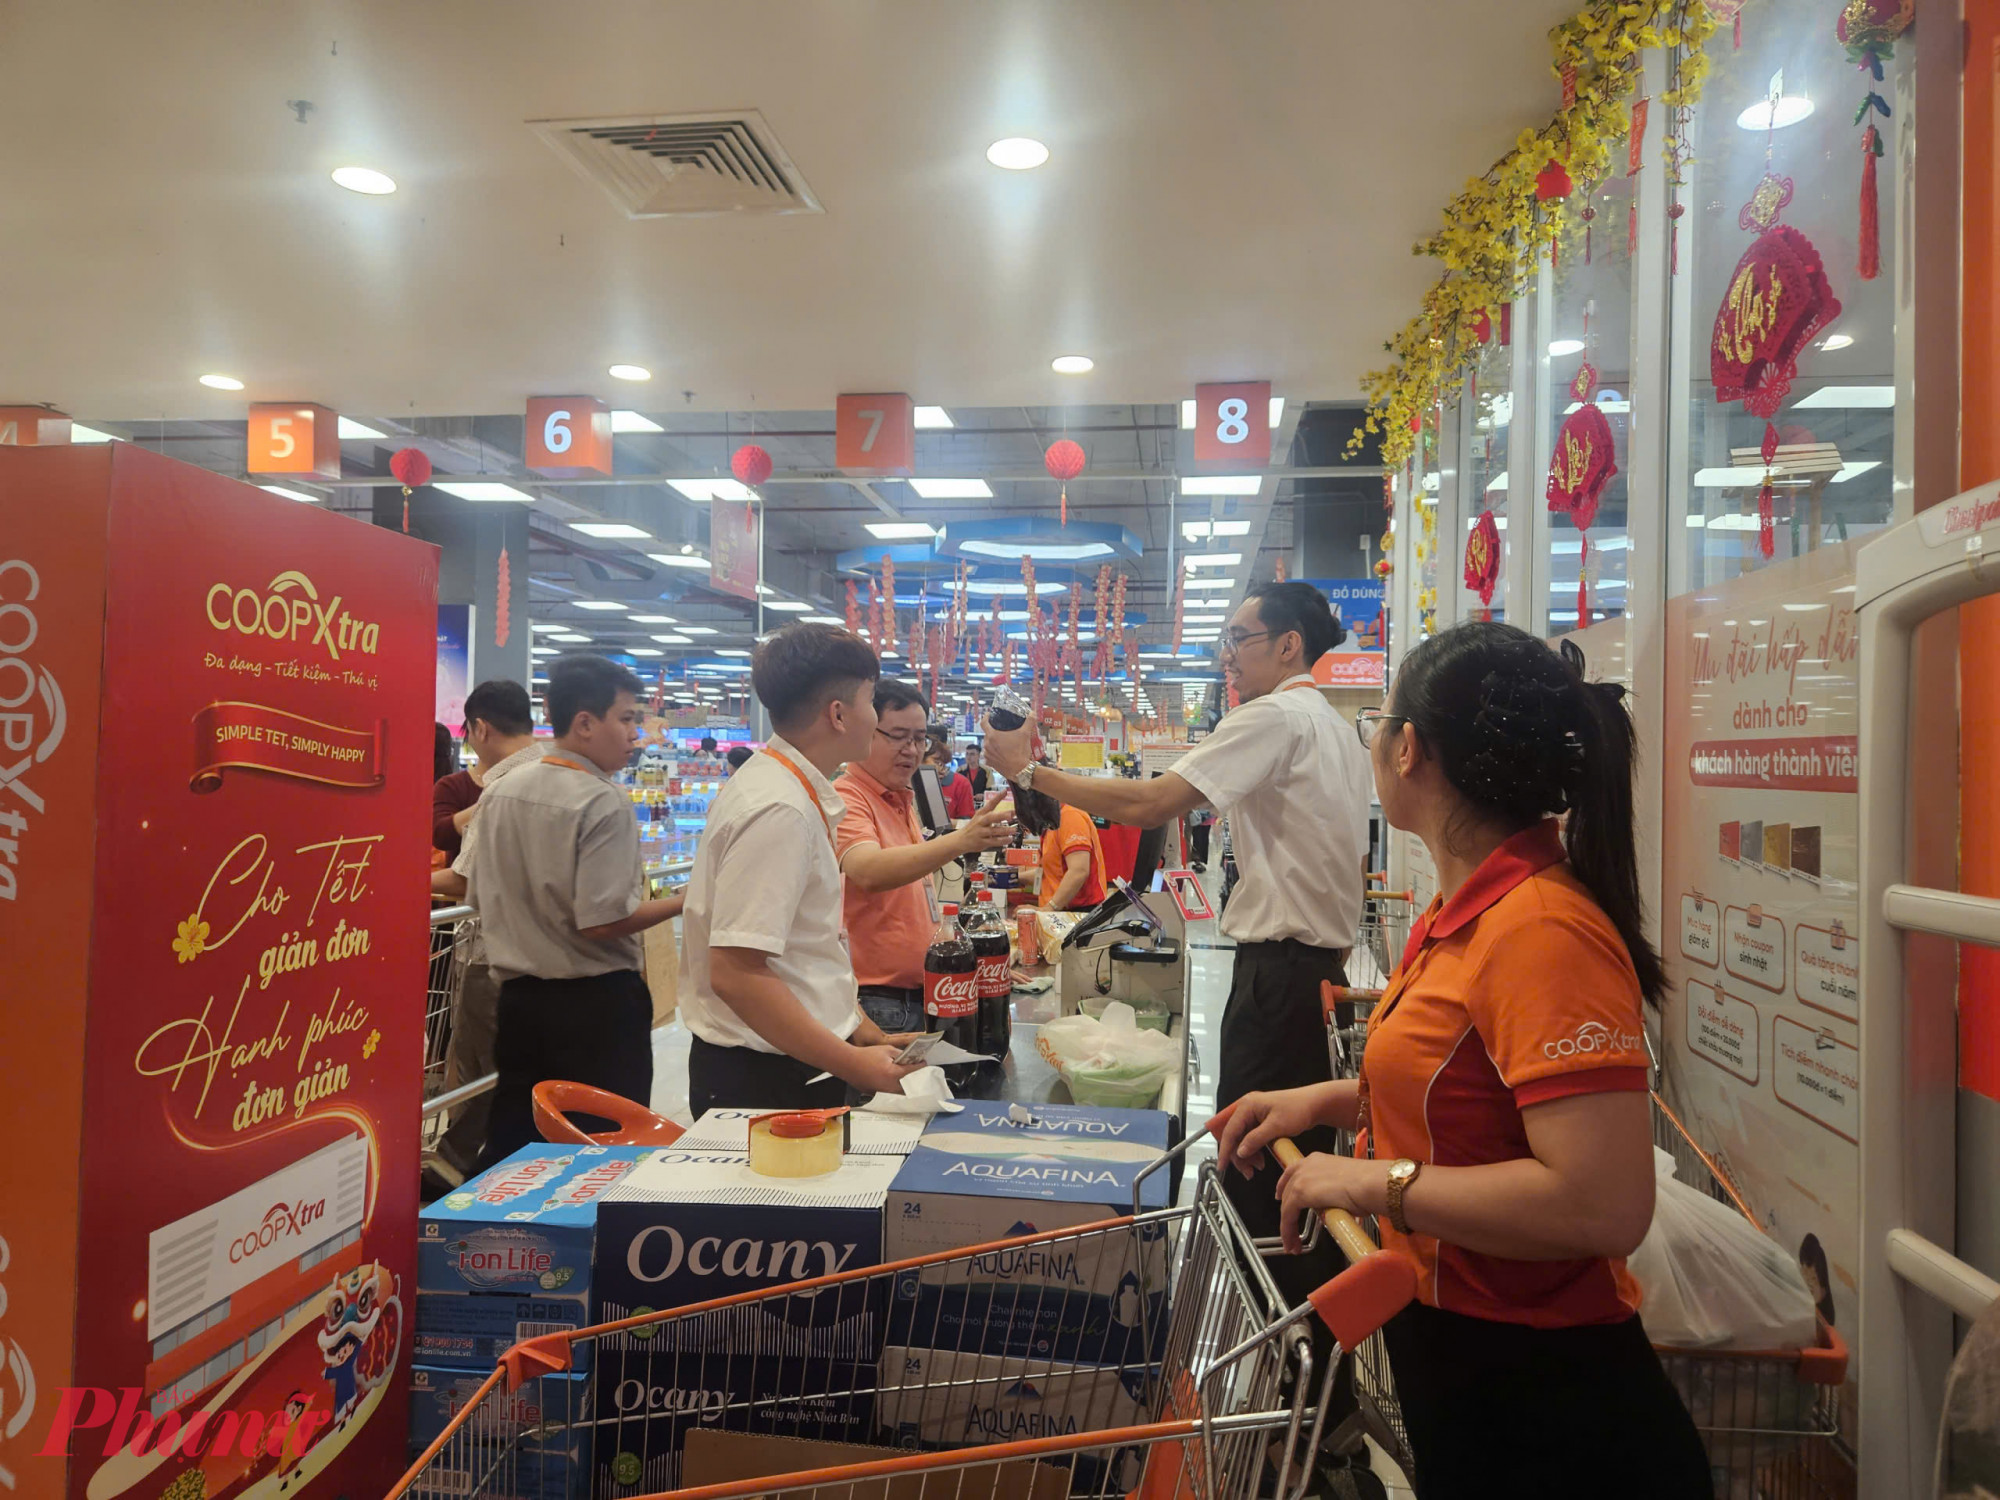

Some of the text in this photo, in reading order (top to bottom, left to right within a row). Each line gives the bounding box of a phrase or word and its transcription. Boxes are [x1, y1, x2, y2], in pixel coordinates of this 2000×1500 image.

[269, 417, 295, 458] 5
[544, 411, 572, 454] 6
[860, 410, 886, 452] 7
[1217, 399, 1249, 443] 8
[204, 652, 379, 690] Đa dạng Tiết kiệm Thú vị
[1733, 697, 1808, 729] dành cho
[216, 726, 365, 763] SIMPLE TET, SIMPLY HAPPY
[1694, 750, 1732, 774] khách
[1735, 750, 1769, 781] hàng
[1773, 748, 1821, 776] thành
[198, 833, 384, 951] Cho Tết
[259, 918, 371, 990] giản đơn
[1740, 951, 1768, 972] sinh nhật
[1751, 939, 1774, 955] coupon
[1820, 978, 1837, 994] cuối
[135, 974, 370, 1119] Hạnh phúc
[233, 1058, 351, 1132] đơn giản
[942, 1162, 1121, 1188] AQUAFINA
[904, 1202, 921, 1214] 24
[508, 1247, 551, 1271] Life
[627, 1225, 857, 1297] Ocany
[966, 1251, 1080, 1284] AQUAFINA
[556, 1272, 569, 1282] 9.5
[942, 1313, 961, 1325] Cho
[905, 1358, 922, 1369] 24
[614, 1379, 736, 1421] Ocany
[966, 1404, 1077, 1439] AQUAFINA
